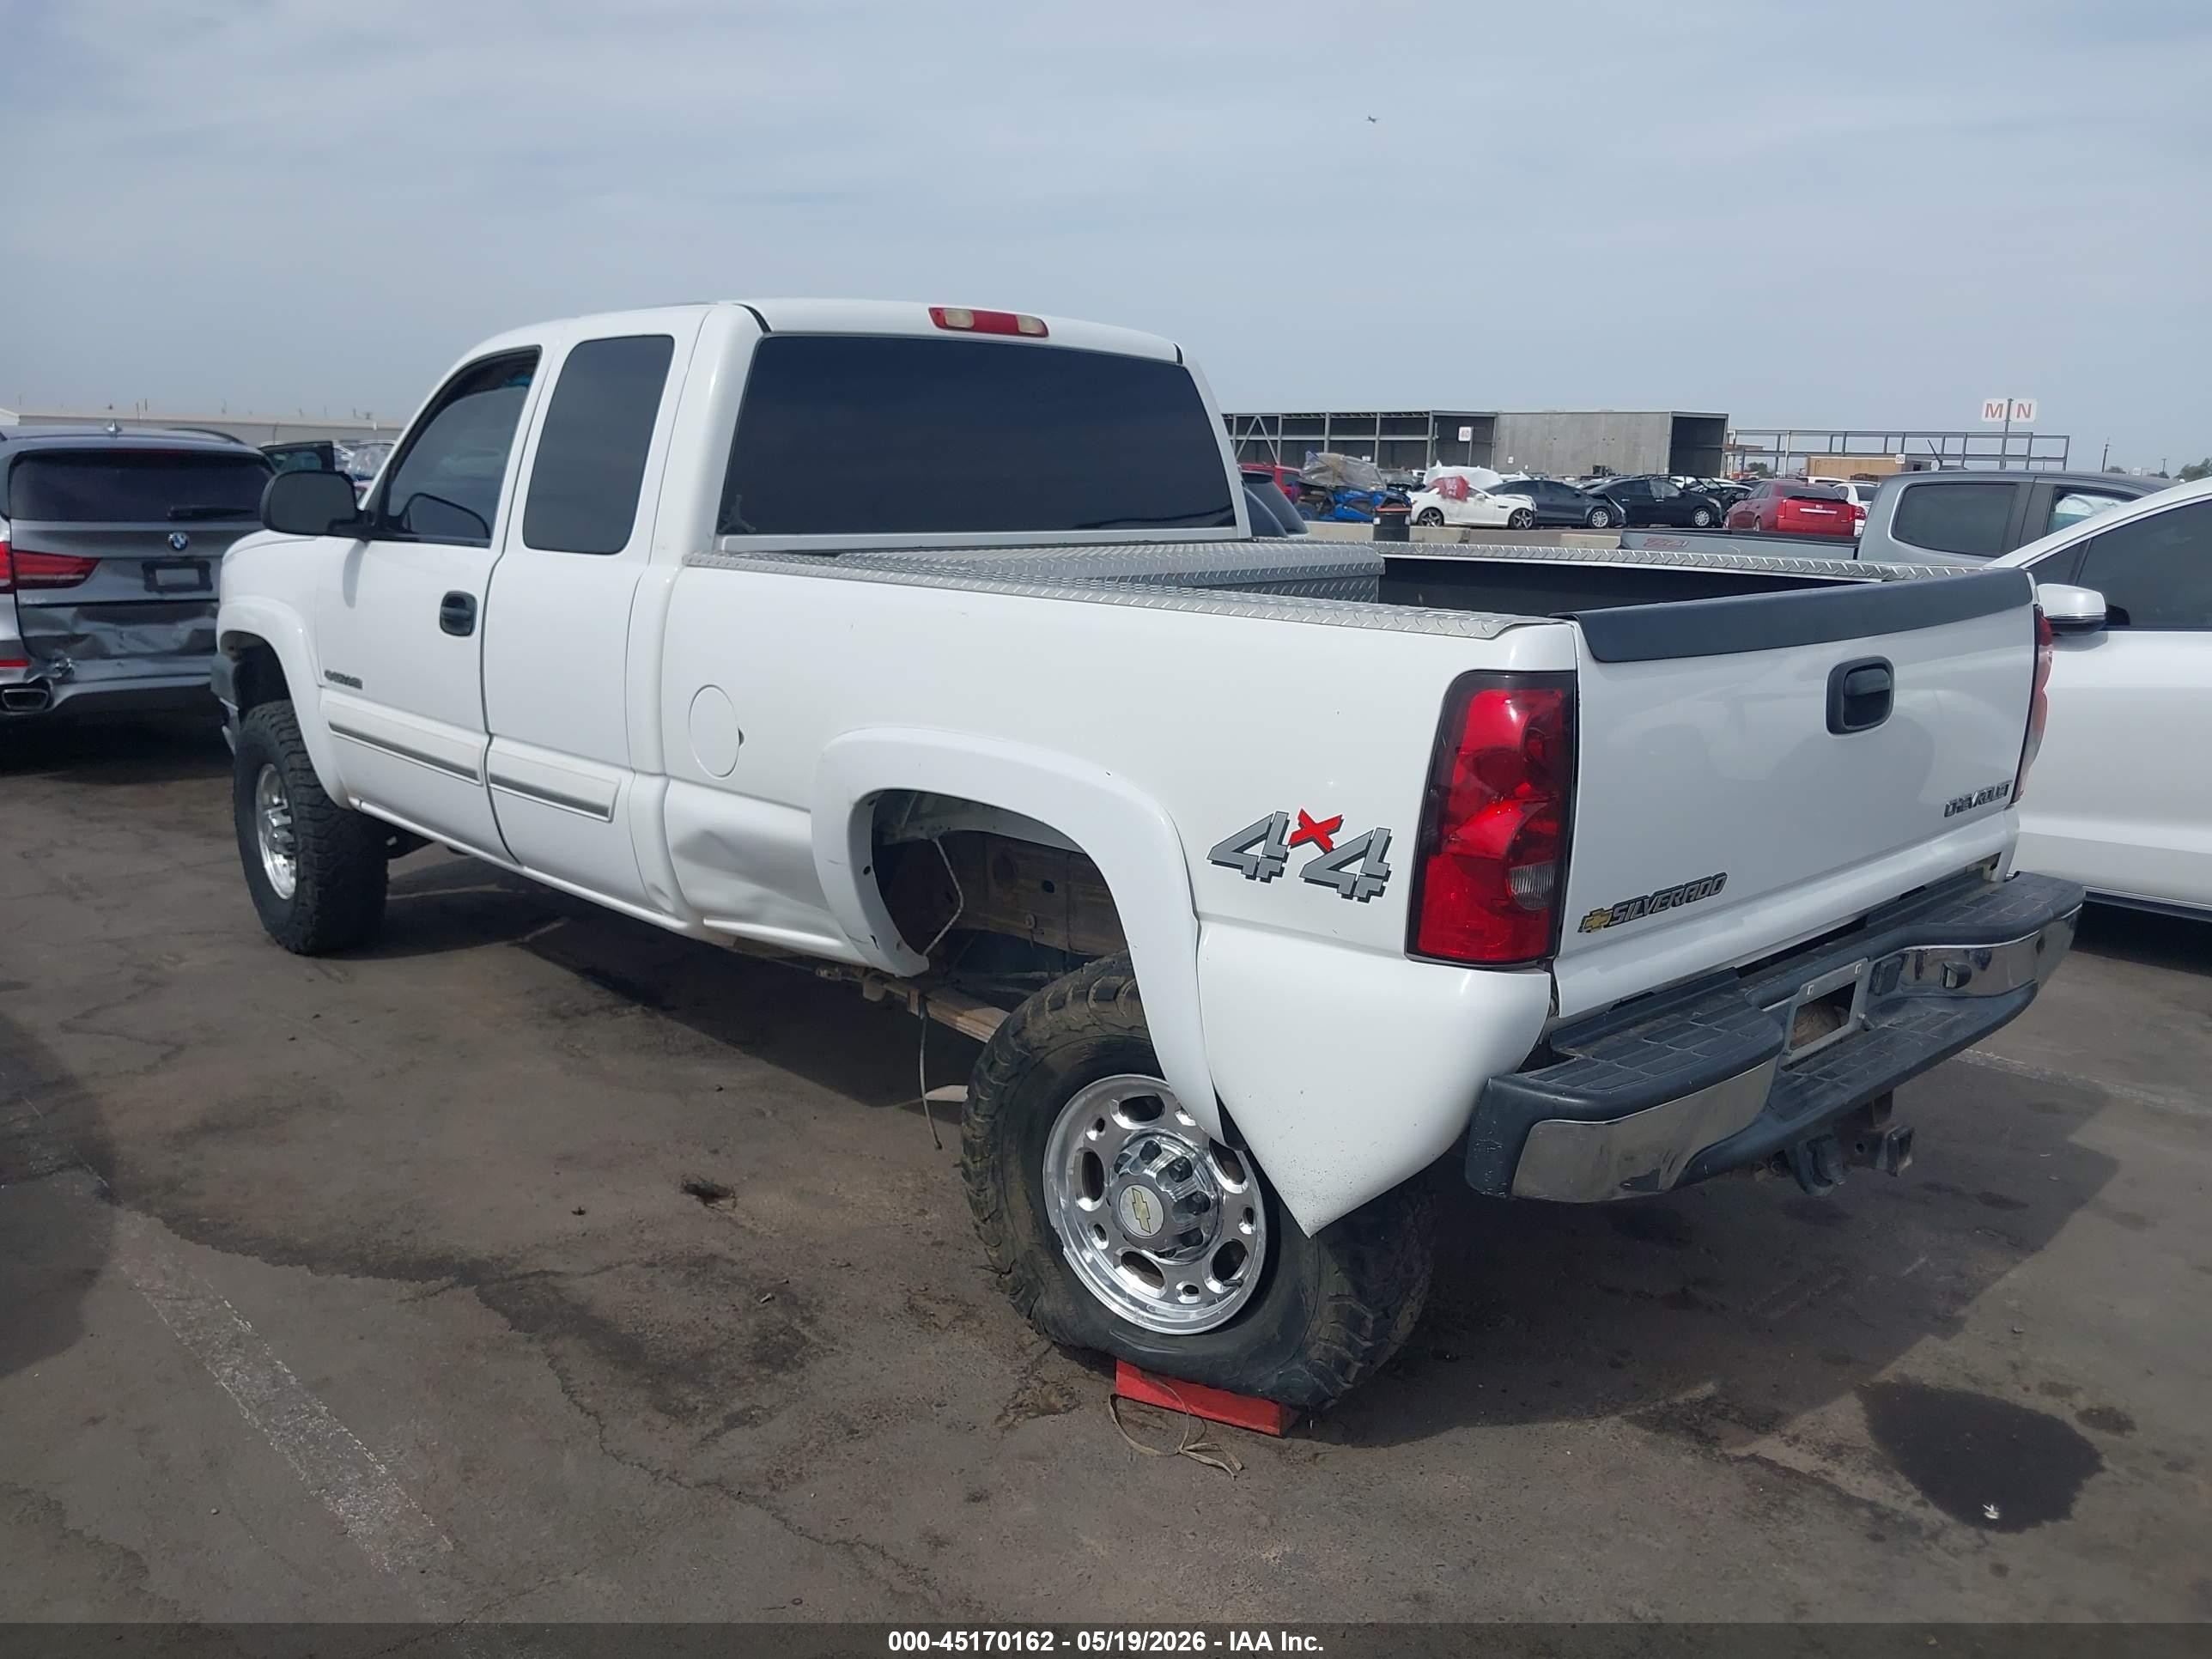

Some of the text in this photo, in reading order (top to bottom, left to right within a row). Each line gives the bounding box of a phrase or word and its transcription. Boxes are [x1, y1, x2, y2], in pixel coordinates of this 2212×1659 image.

[1984, 403, 2004, 418] M
[2016, 403, 2032, 418] N
[1608, 872, 1728, 927] SILVERADO
